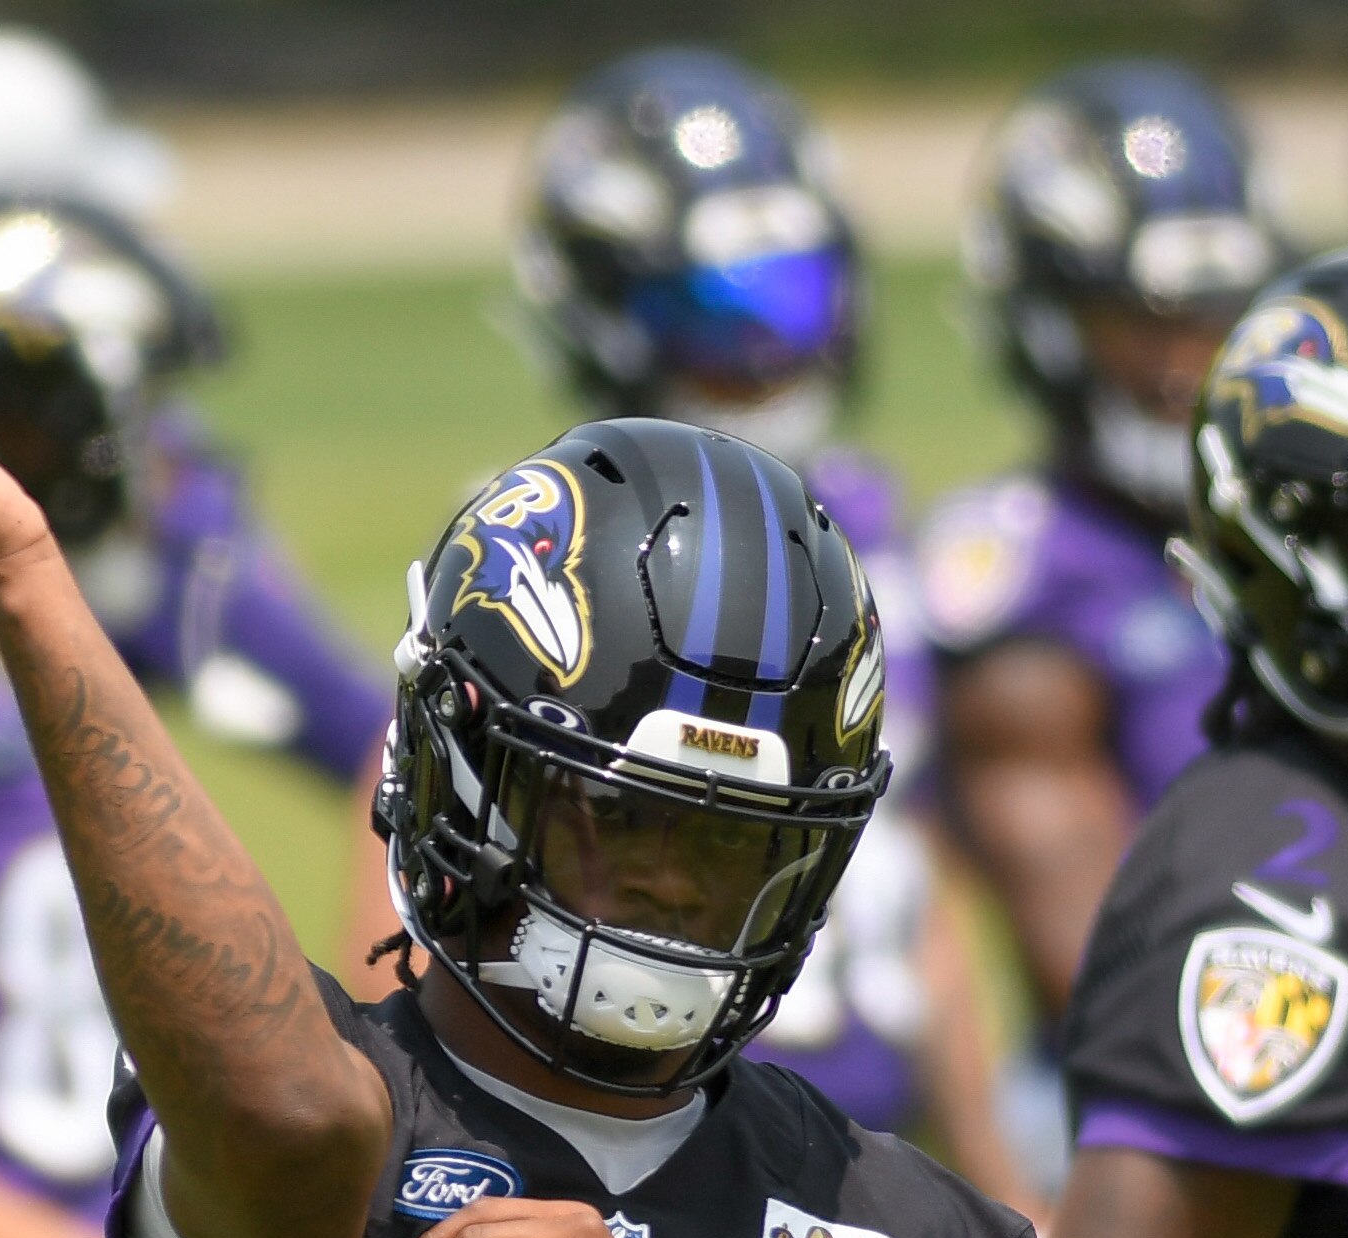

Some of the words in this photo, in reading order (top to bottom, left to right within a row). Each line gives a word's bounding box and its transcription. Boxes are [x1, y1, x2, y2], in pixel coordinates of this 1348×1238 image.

[681, 723, 761, 758] RAVENS
[1254, 798, 1338, 886] 2
[402, 1163, 491, 1204] Ford
